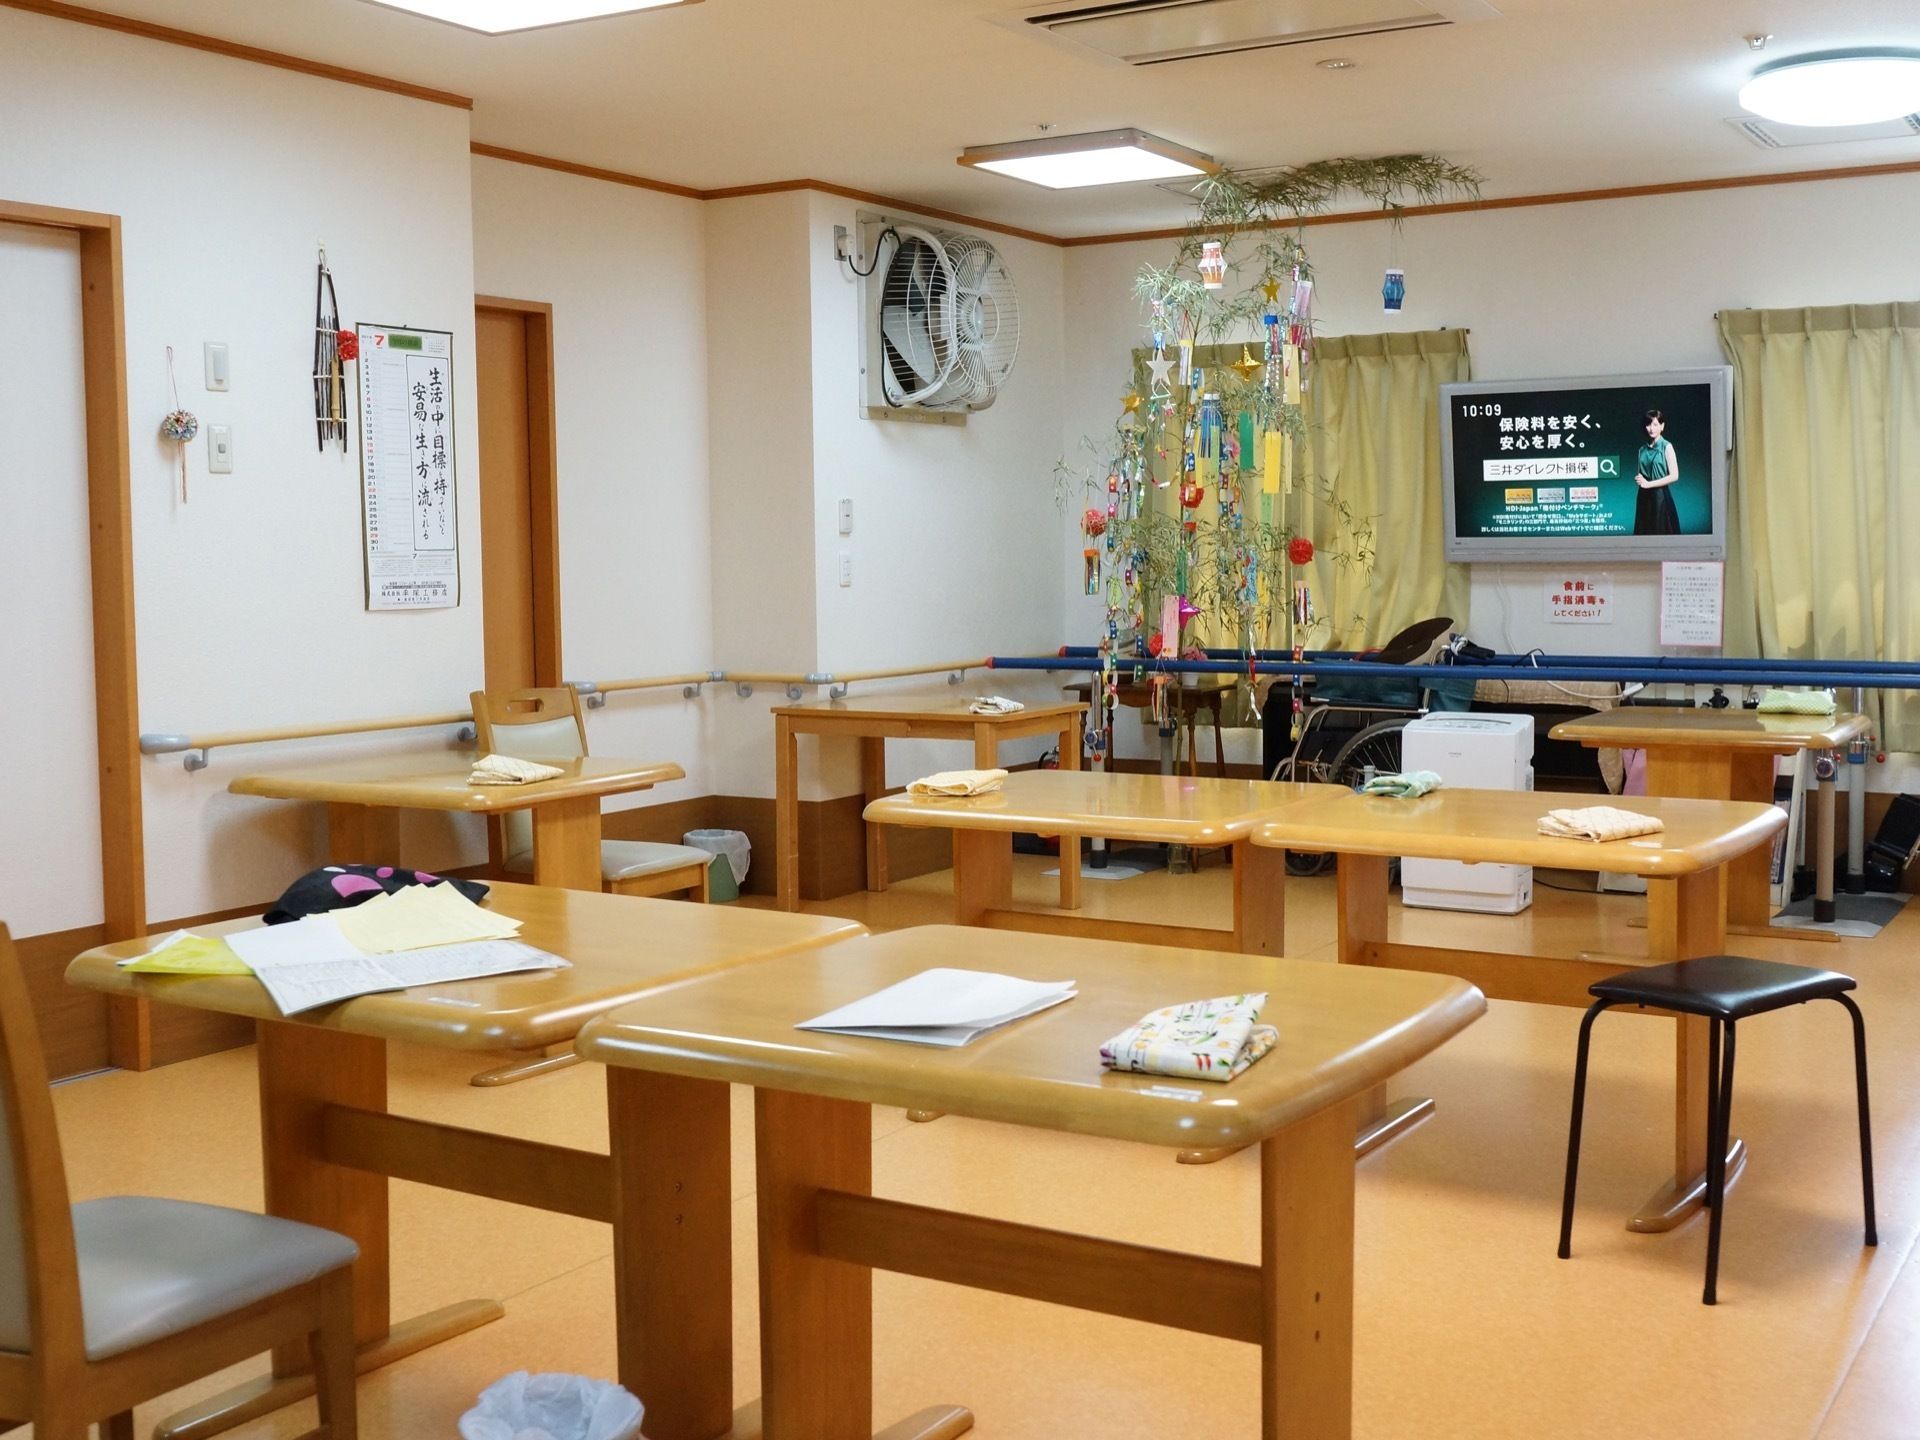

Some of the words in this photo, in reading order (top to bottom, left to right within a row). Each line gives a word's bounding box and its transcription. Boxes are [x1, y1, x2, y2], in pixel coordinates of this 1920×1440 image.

[374, 335, 385, 346] 7
[1463, 404, 1502, 417] 10:09
[1499, 414, 1601, 432] 保険料を安く、
[1500, 433, 1585, 450] 安心を厚く。
[1490, 462, 1589, 476] 三井ダイレクト損保
[1564, 581, 1595, 591] 食前に
[1551, 595, 1606, 605] 手指消毒を
